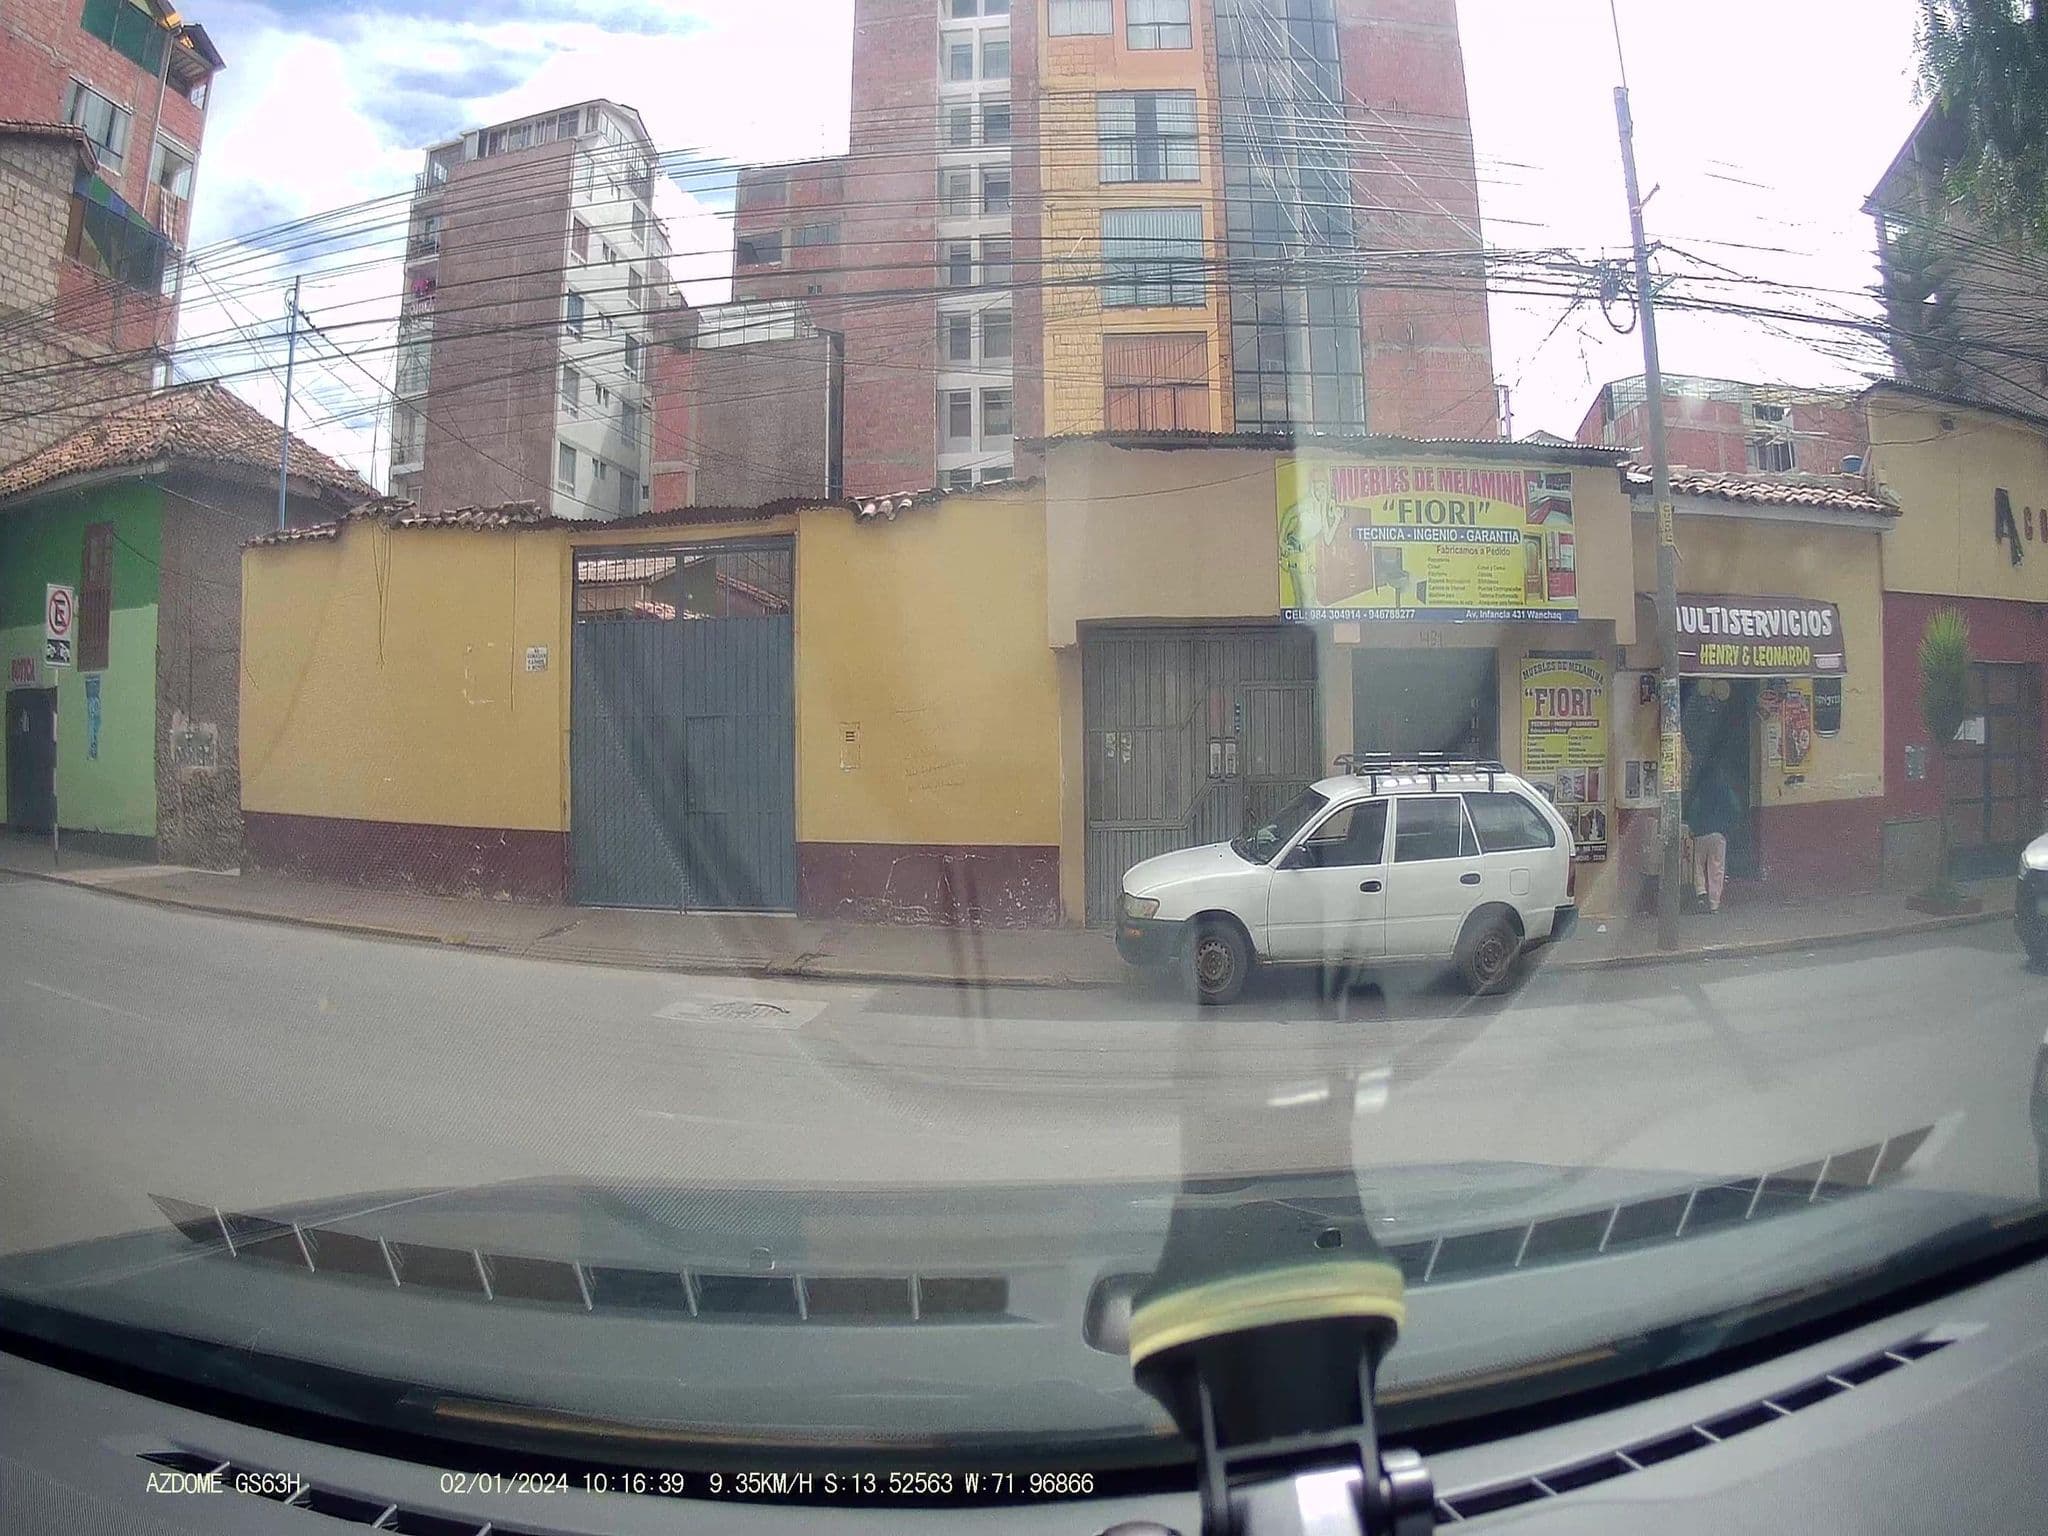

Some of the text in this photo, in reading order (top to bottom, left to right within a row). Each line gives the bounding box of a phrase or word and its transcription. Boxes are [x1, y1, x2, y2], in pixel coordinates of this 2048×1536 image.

[1332, 465, 1525, 508] MUEBLES DE MELAMINA
[1357, 528, 1404, 540] TECNICA
[1413, 529, 1458, 542] INGENIO
[1466, 530, 1519, 544] GARANTIA
[1436, 545, 1478, 555] Fabricamos
[1485, 546, 1511, 556] Pedido
[1285, 609, 1308, 620] CEL:
[1480, 609, 1511, 619] Infancia
[1512, 610, 1525, 619] 431
[1527, 611, 1562, 621] Wanchaq
[1700, 643, 1740, 666] HENRY
[1742, 644, 1751, 666] &
[1753, 645, 1811, 668] LEONARDO
[1558, 661, 1567, 671] DE
